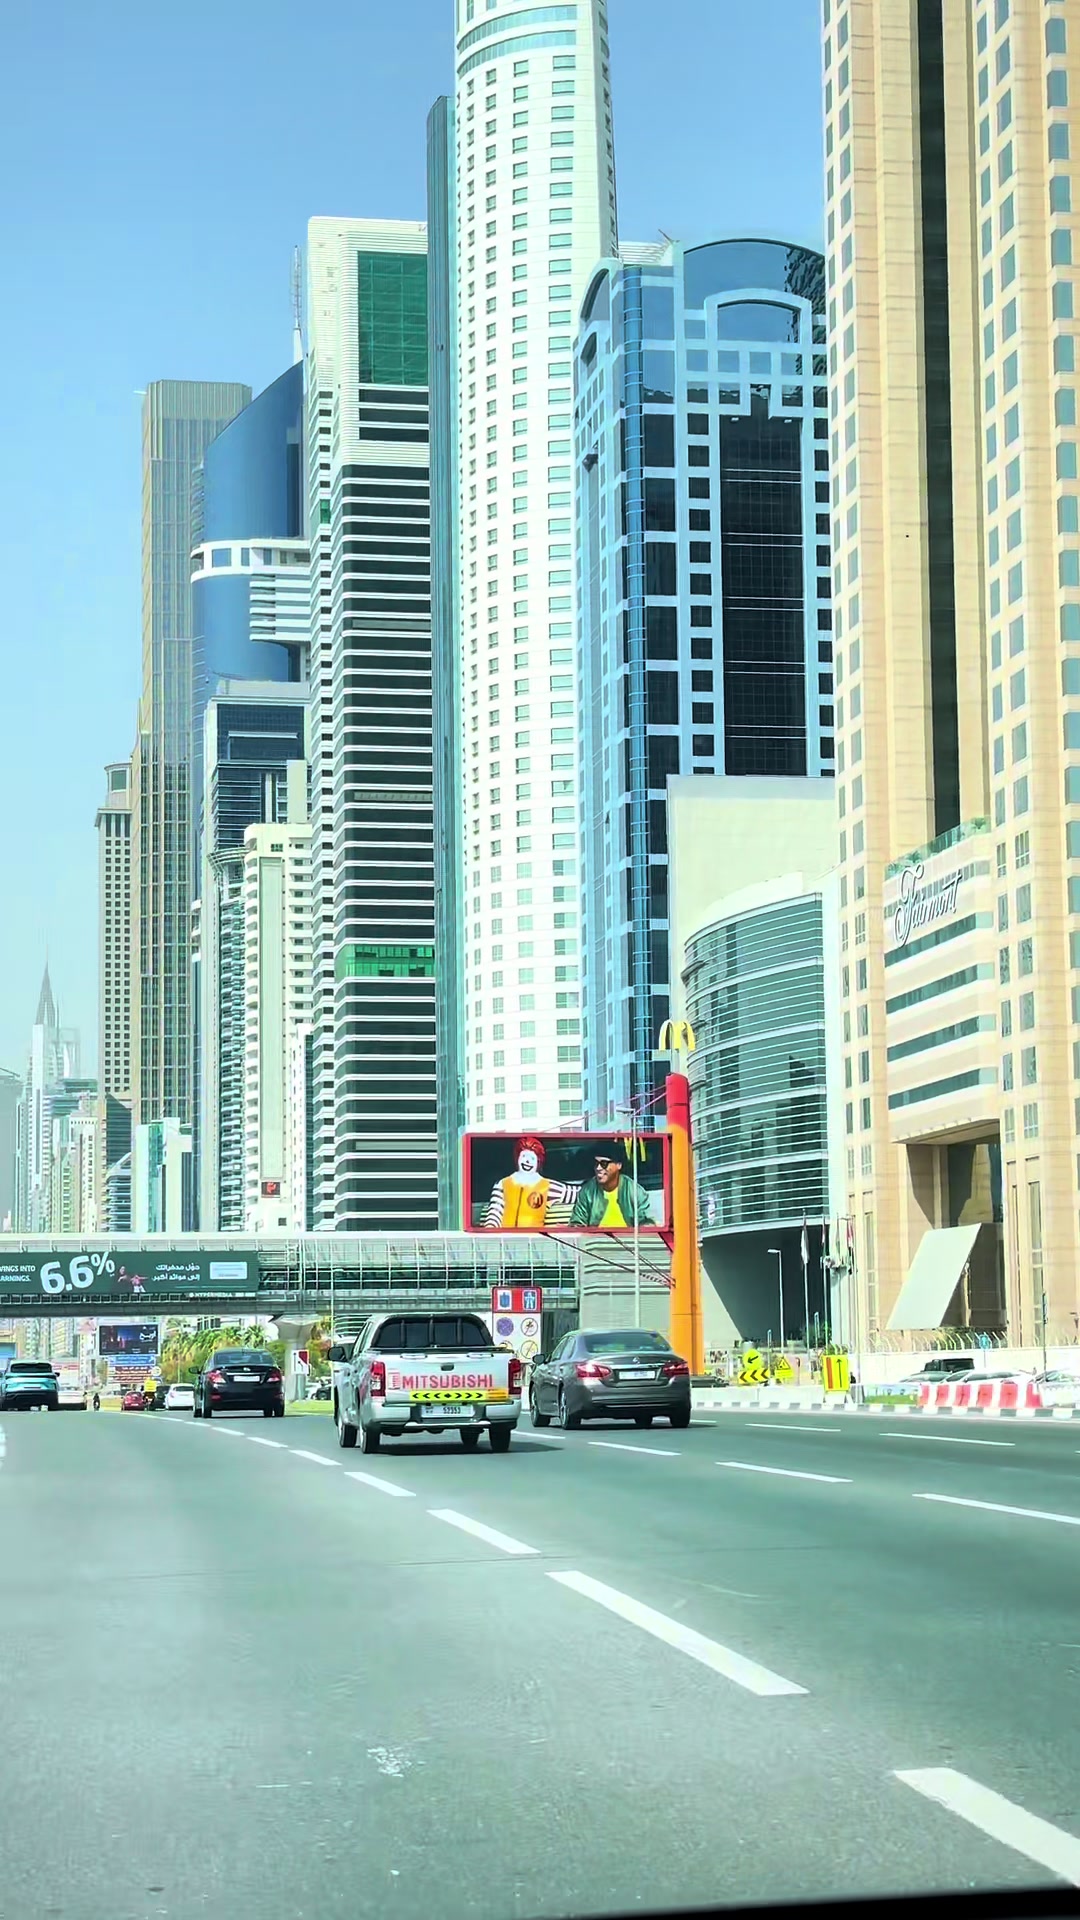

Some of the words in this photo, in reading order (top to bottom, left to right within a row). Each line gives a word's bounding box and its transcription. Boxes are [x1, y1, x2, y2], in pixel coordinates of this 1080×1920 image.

[894, 864, 963, 949] Fairmont
[40, 1251, 115, 1294] 6.6%
[402, 1374, 493, 1389] MITSUBISHI
